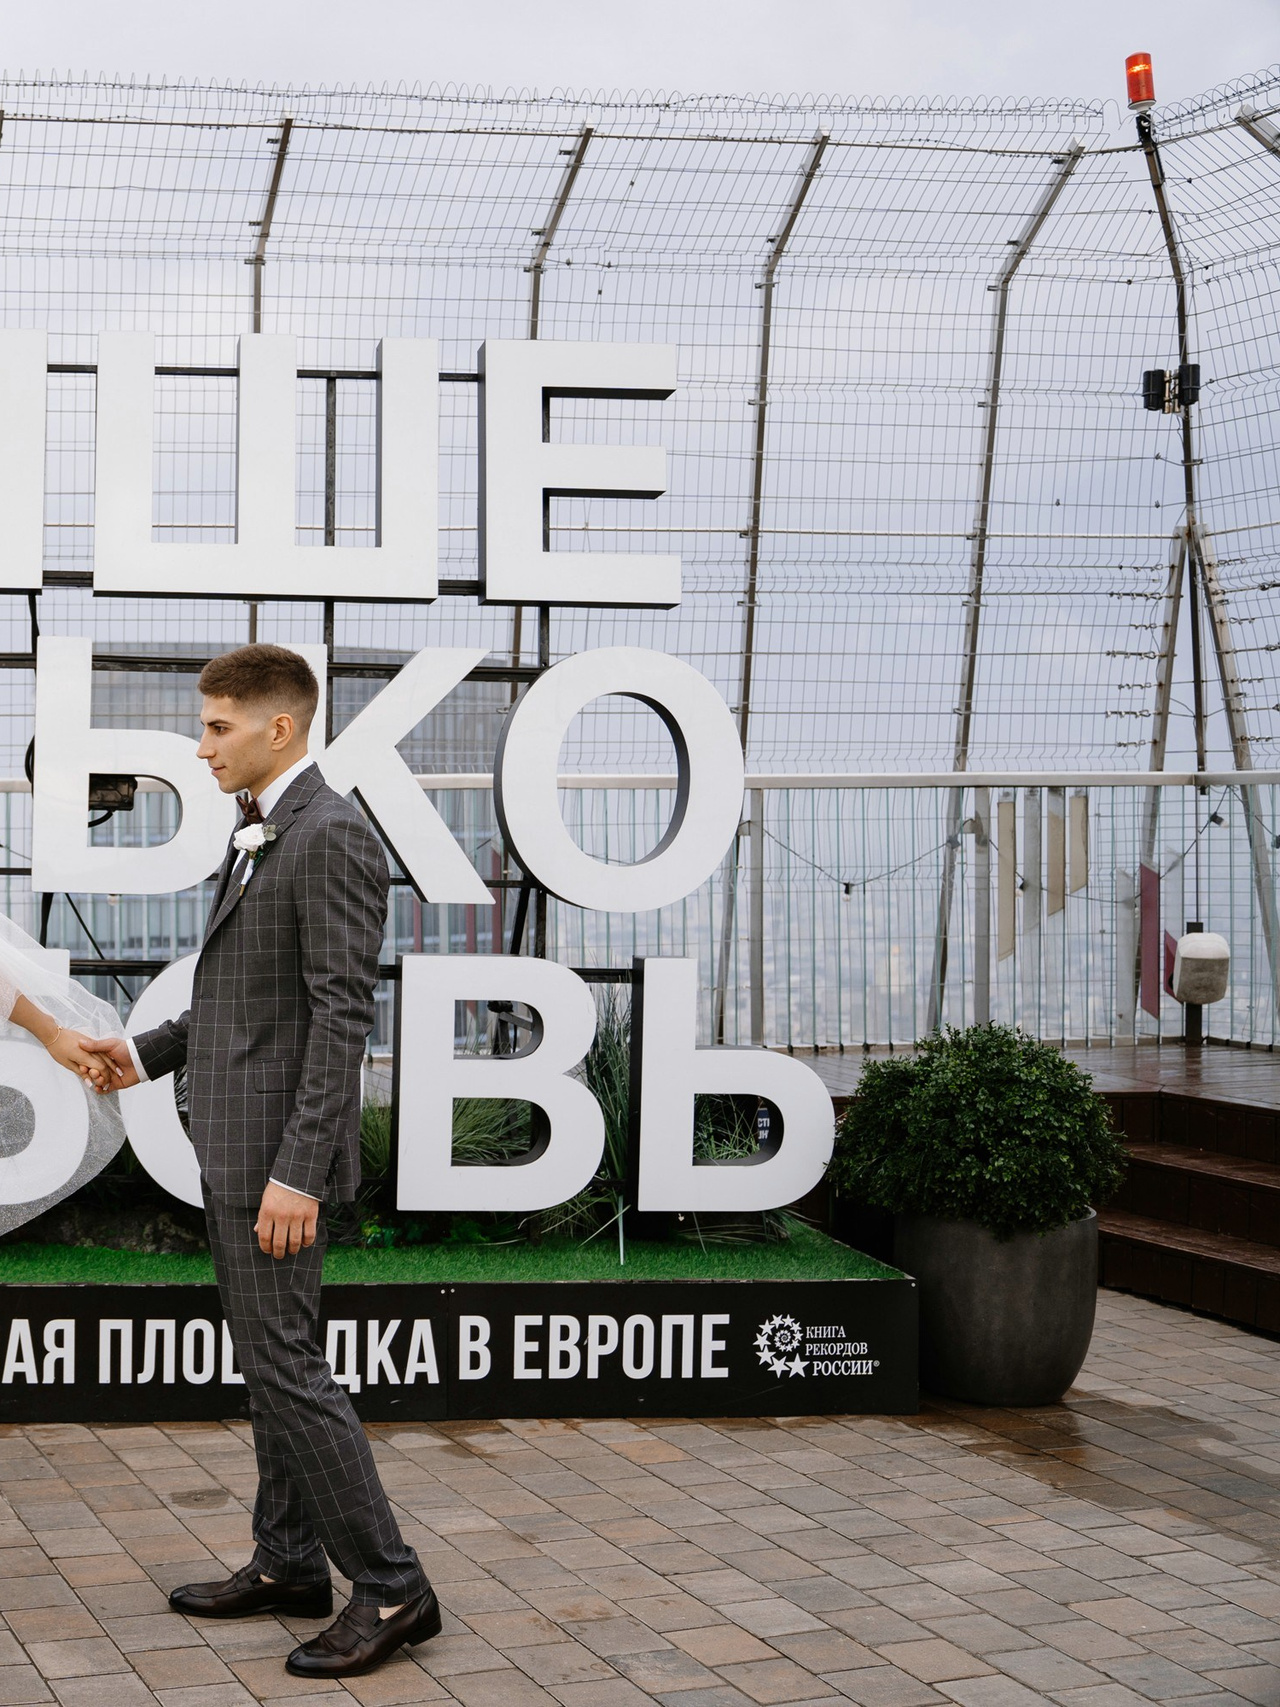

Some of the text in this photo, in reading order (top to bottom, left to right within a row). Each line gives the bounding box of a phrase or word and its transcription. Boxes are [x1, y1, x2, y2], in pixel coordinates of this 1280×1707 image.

[805, 1325, 847, 1339] КНИГА
[98, 1318, 440, 1394] ПЛОДКА
[458, 1315, 492, 1380] В
[513, 1313, 731, 1380] ЕВРОПЕ
[805, 1342, 869, 1358] РЕКОРДОВ
